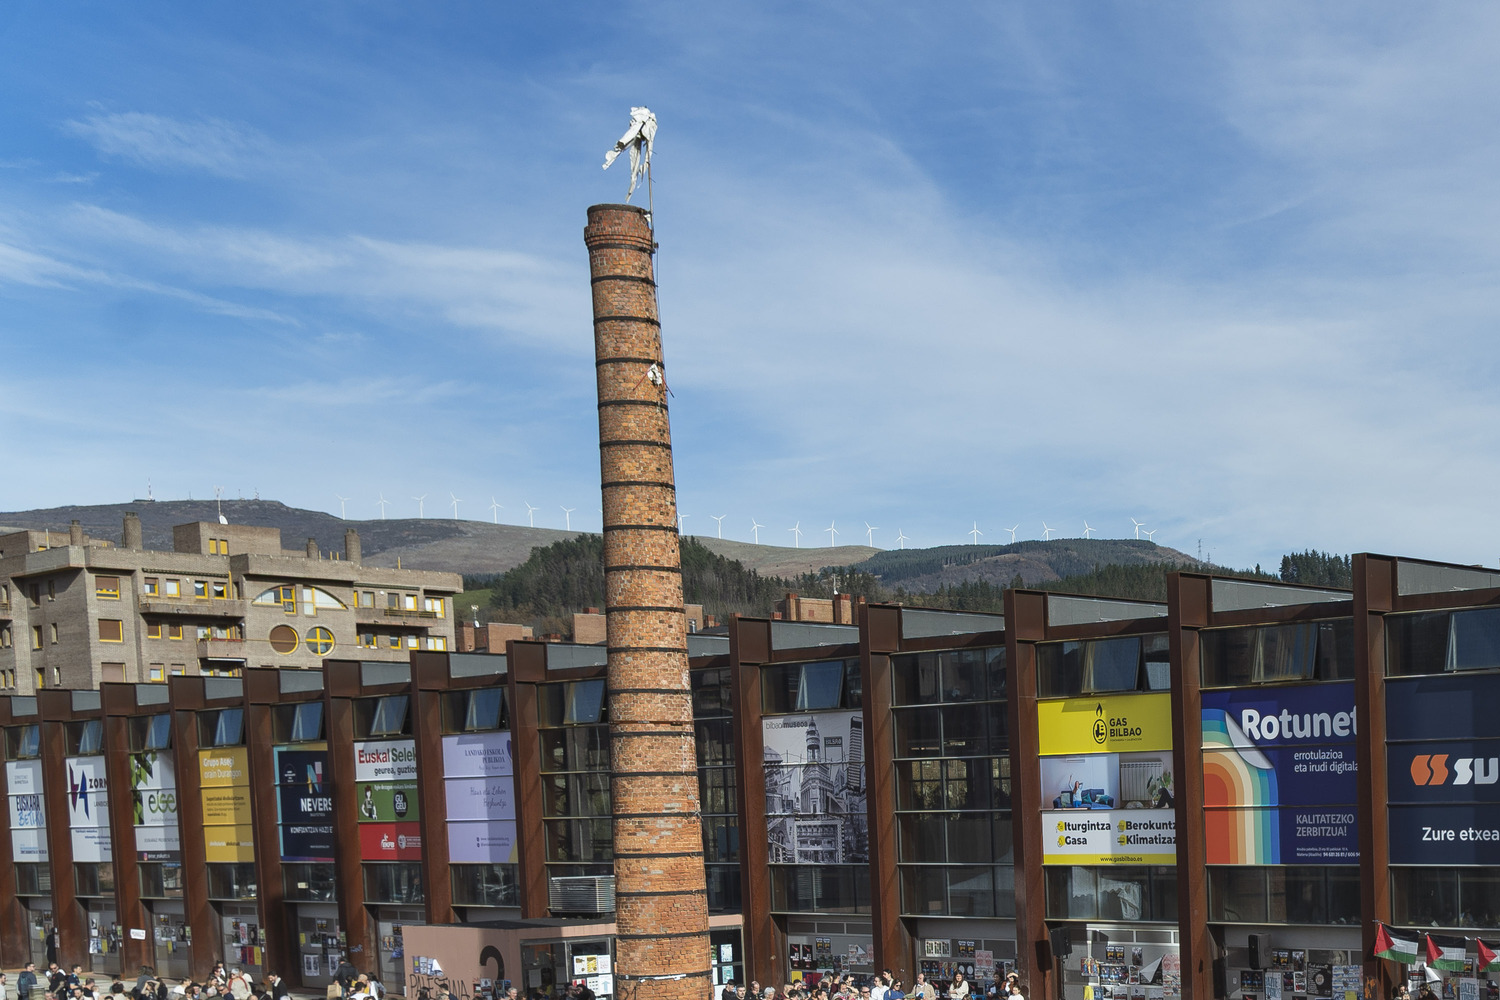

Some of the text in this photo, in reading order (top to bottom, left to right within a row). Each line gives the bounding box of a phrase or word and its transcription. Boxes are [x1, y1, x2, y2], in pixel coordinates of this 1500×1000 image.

[1109, 718, 1127, 727] GAS
[1109, 727, 1142, 737] BILBAO
[358, 748, 390, 764] Euskal
[1294, 749, 1343, 760] errotulazioa
[203, 758, 219, 767] Grupo
[1294, 763, 1307, 772] eta
[1309, 762, 1327, 772] irudi
[16, 795, 40, 811] EUSKARA
[1296, 814, 1354, 824] KALITATEZKO
[1064, 820, 1111, 832] Iturgintza
[1296, 826, 1347, 837] ZERBITZUA!
[1422, 827, 1456, 841] Zure
[1064, 836, 1087, 845] Gasa
